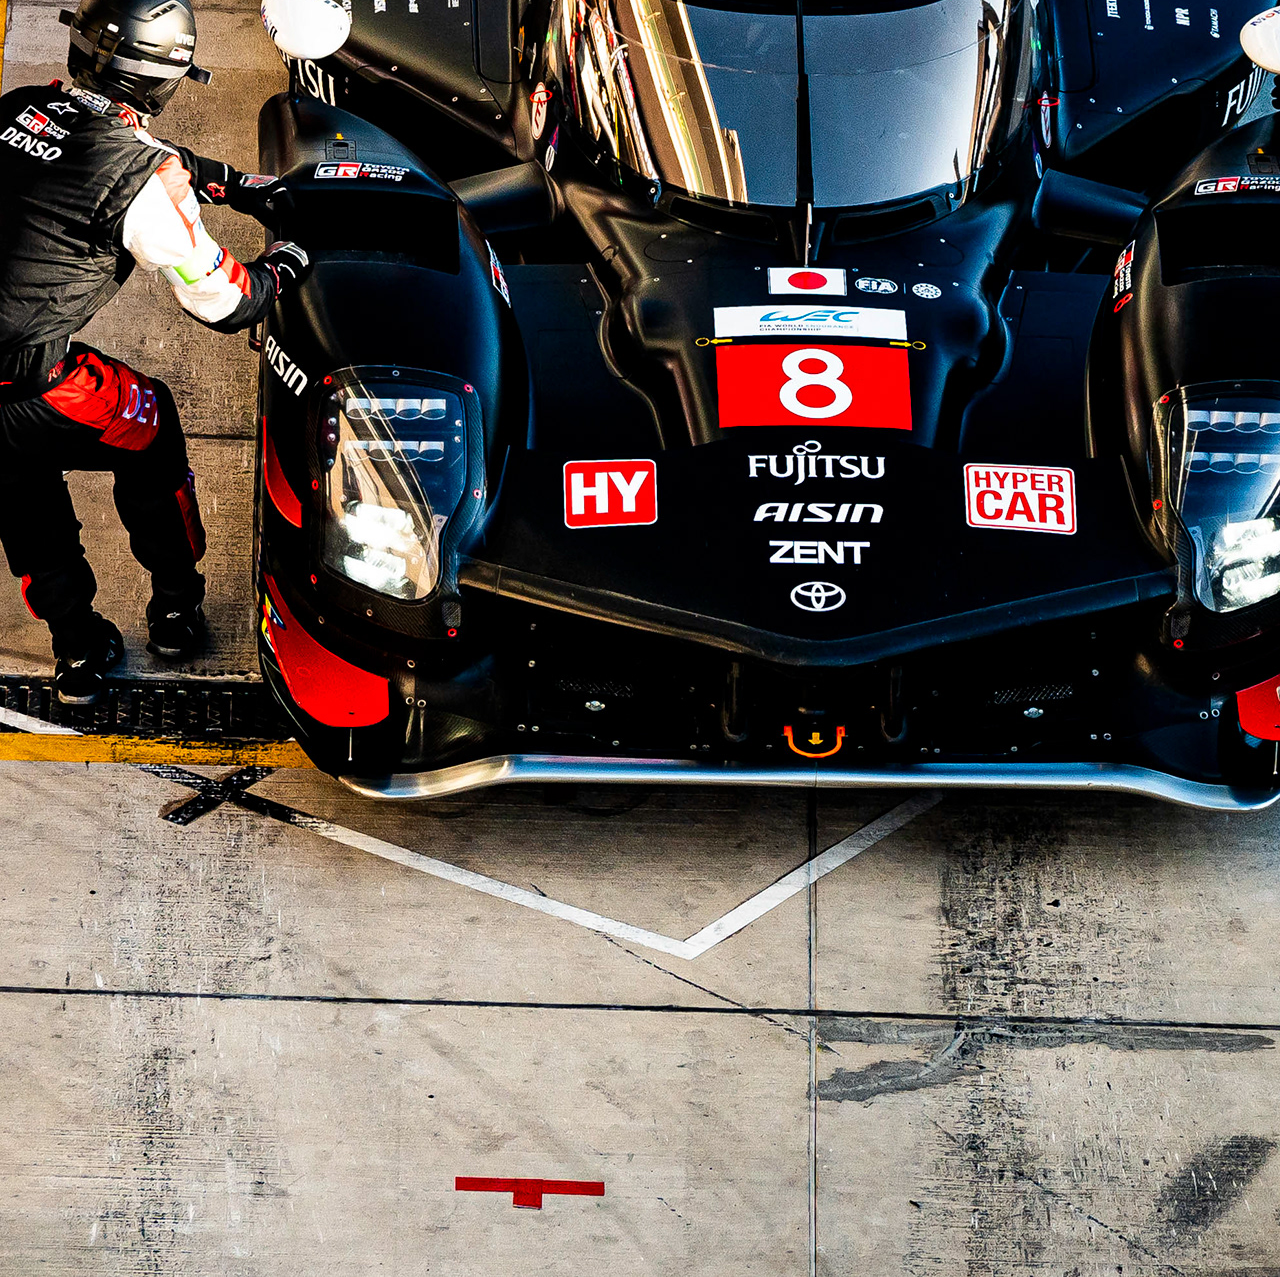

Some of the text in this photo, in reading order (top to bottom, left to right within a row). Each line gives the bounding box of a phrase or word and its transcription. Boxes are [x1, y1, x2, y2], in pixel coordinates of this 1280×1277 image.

[18, 113, 41, 133] GR
[359, 172, 403, 182] Racing
[858, 279, 894, 292] FIA
[1113, 292, 1134, 313] 8
[759, 309, 860, 323] WEC
[264, 335, 308, 397] AISIN
[778, 347, 853, 419] 8
[748, 440, 886, 485] FUJITSU
[973, 470, 1064, 493] HYPER
[570, 470, 649, 517] HY
[753, 502, 884, 523] AISIN
[975, 490, 1067, 526] CAR
[769, 541, 871, 564] ZENT
